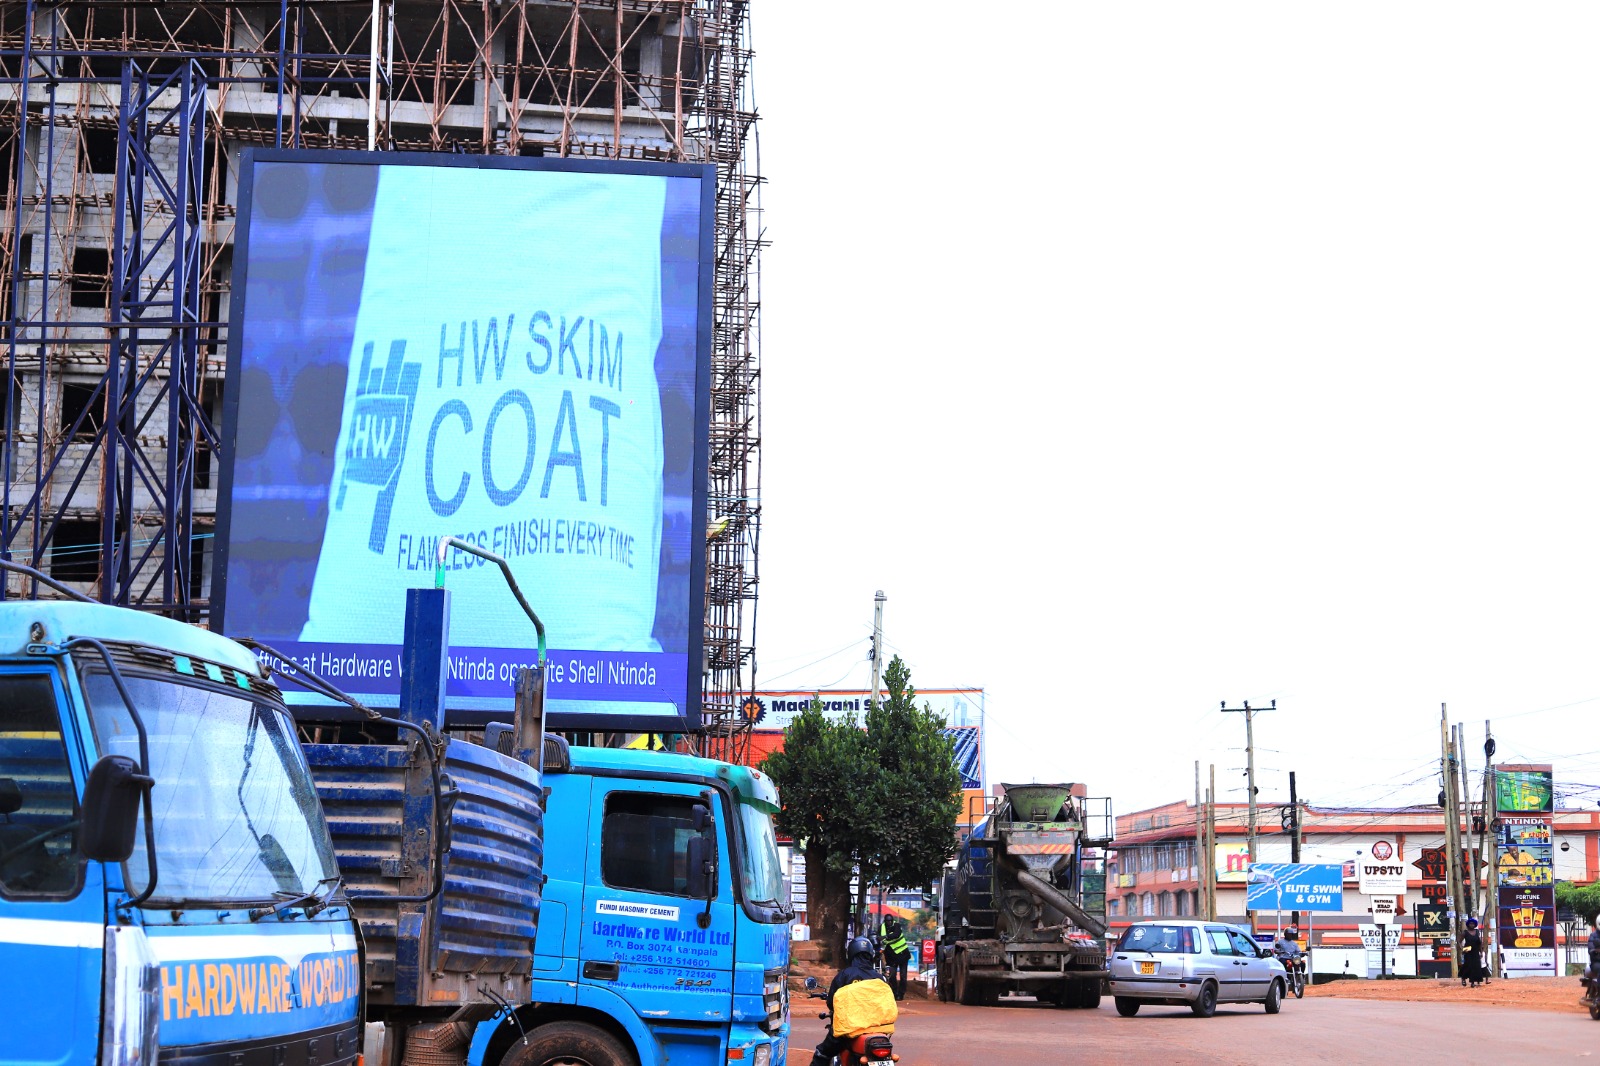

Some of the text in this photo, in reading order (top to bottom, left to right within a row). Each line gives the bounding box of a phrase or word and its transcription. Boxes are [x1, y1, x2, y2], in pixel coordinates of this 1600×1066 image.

[437, 310, 623, 392] HW SKIM
[352, 414, 396, 460] HW
[425, 388, 621, 517] COAT
[493, 518, 550, 560] FINISH
[555, 519, 605, 556] EVERY
[609, 526, 634, 569] TIME
[302, 652, 317, 675] at
[320, 652, 393, 678] Hardware
[447, 655, 495, 682] Ntinda
[568, 659, 604, 684] Shell
[608, 660, 656, 685] Ntinda
[771, 698, 860, 712] Madvani
[1364, 866, 1404, 875] UPSTU
[1285, 884, 1341, 894] ELITE SWIM
[1295, 895, 1331, 904] & GYM
[599, 903, 675, 917] FUNDI MASONRY CEMENT
[593, 920, 733, 946] Hardware World Ltd.
[626, 941, 645, 951] Box
[648, 943, 673, 953] 3074
[631, 954, 653, 963] +256
[643, 967, 664, 975] +256
[667, 969, 682, 977] 772
[685, 970, 717, 979] 721246
[160, 953, 359, 1021] HARDWARE WORLD LTD
[675, 977, 712, 987] 2644
